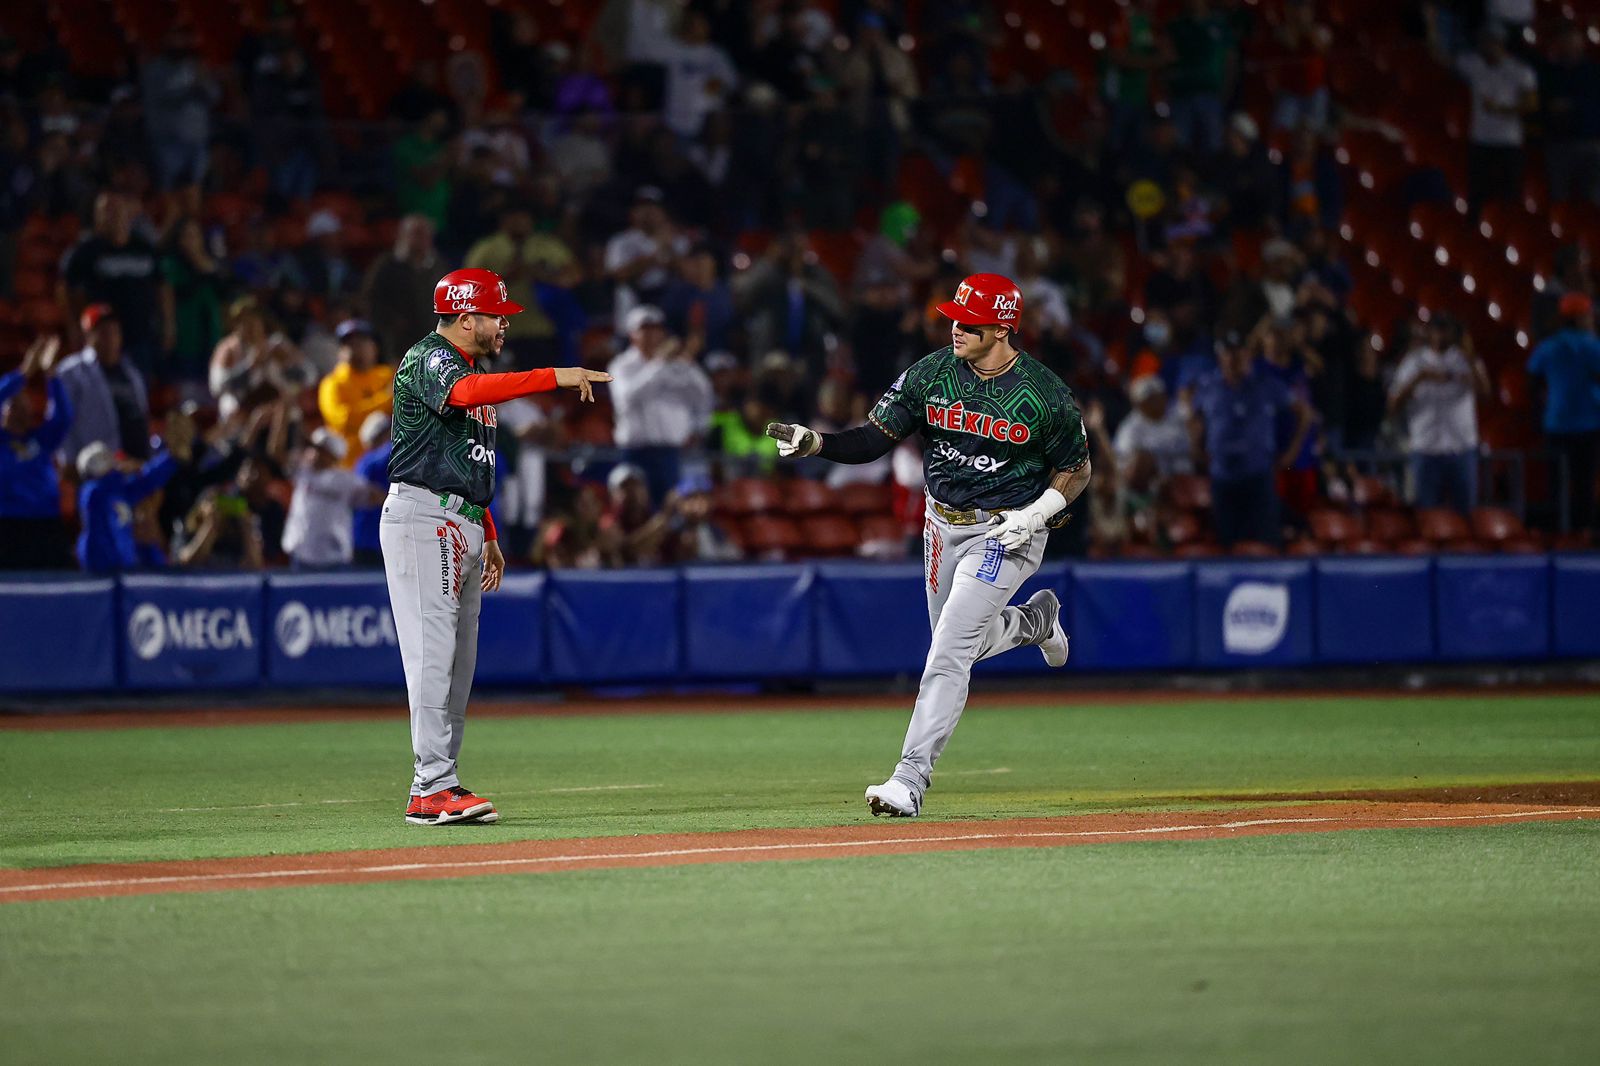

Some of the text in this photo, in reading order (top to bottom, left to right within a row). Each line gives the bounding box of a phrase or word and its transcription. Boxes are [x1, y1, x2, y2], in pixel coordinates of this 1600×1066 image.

[445, 283, 475, 301] Red
[452, 301, 471, 311] Cola
[992, 293, 1019, 311] Red
[997, 310, 1016, 320] Cola
[926, 401, 1031, 444] MÉXICO
[440, 537, 450, 596] caliente.mx
[167, 606, 253, 650] MEGA
[314, 605, 397, 648] MEGA
